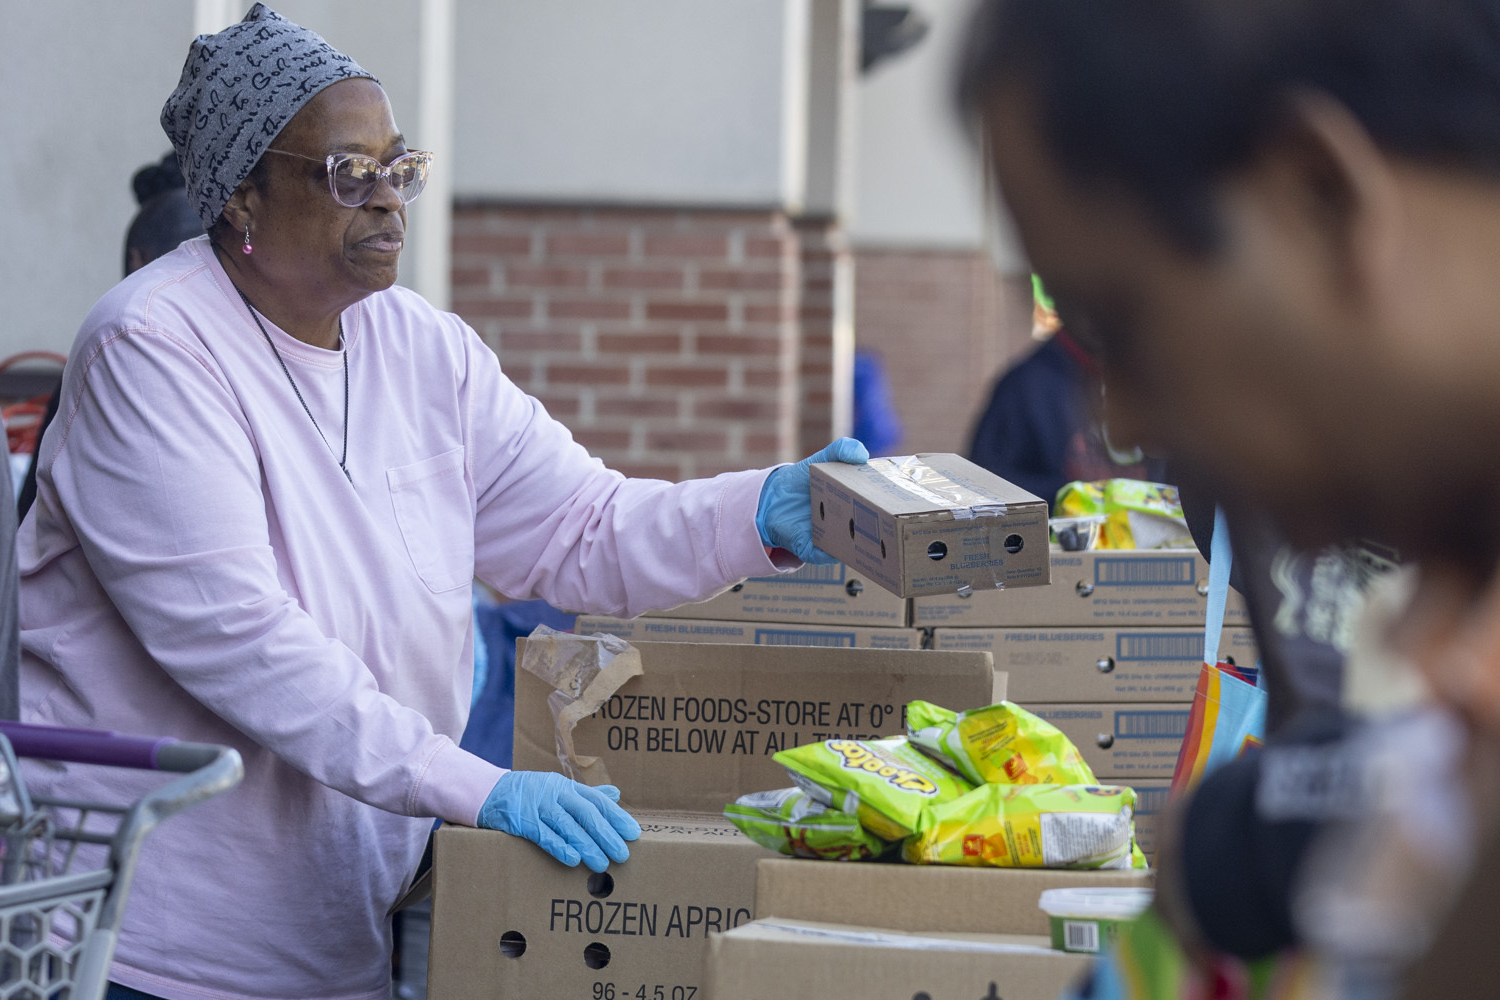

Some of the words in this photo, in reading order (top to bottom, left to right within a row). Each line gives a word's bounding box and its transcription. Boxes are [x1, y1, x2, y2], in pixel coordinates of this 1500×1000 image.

[964, 553, 990, 561] FRESH
[950, 560, 1004, 570] BLUEBERRIES
[645, 623, 677, 633] FRESH
[678, 625, 744, 636] BLUEBERRIES
[1005, 633, 1038, 641] FRESH
[1038, 633, 1105, 641] BLUEBERRIES
[592, 694, 666, 721] ROZEN
[673, 696, 831, 728] FOODS-STORE
[836, 702, 865, 728] AT
[869, 703, 894, 729] 0°
[607, 725, 639, 751] OR
[646, 727, 728, 755] BELOW
[731, 730, 760, 755] AT
[639, 823, 740, 833] ODS-STO
[549, 898, 658, 937] FROZEN
[664, 904, 751, 939] APRIC
[592, 981, 616, 1000] 96
